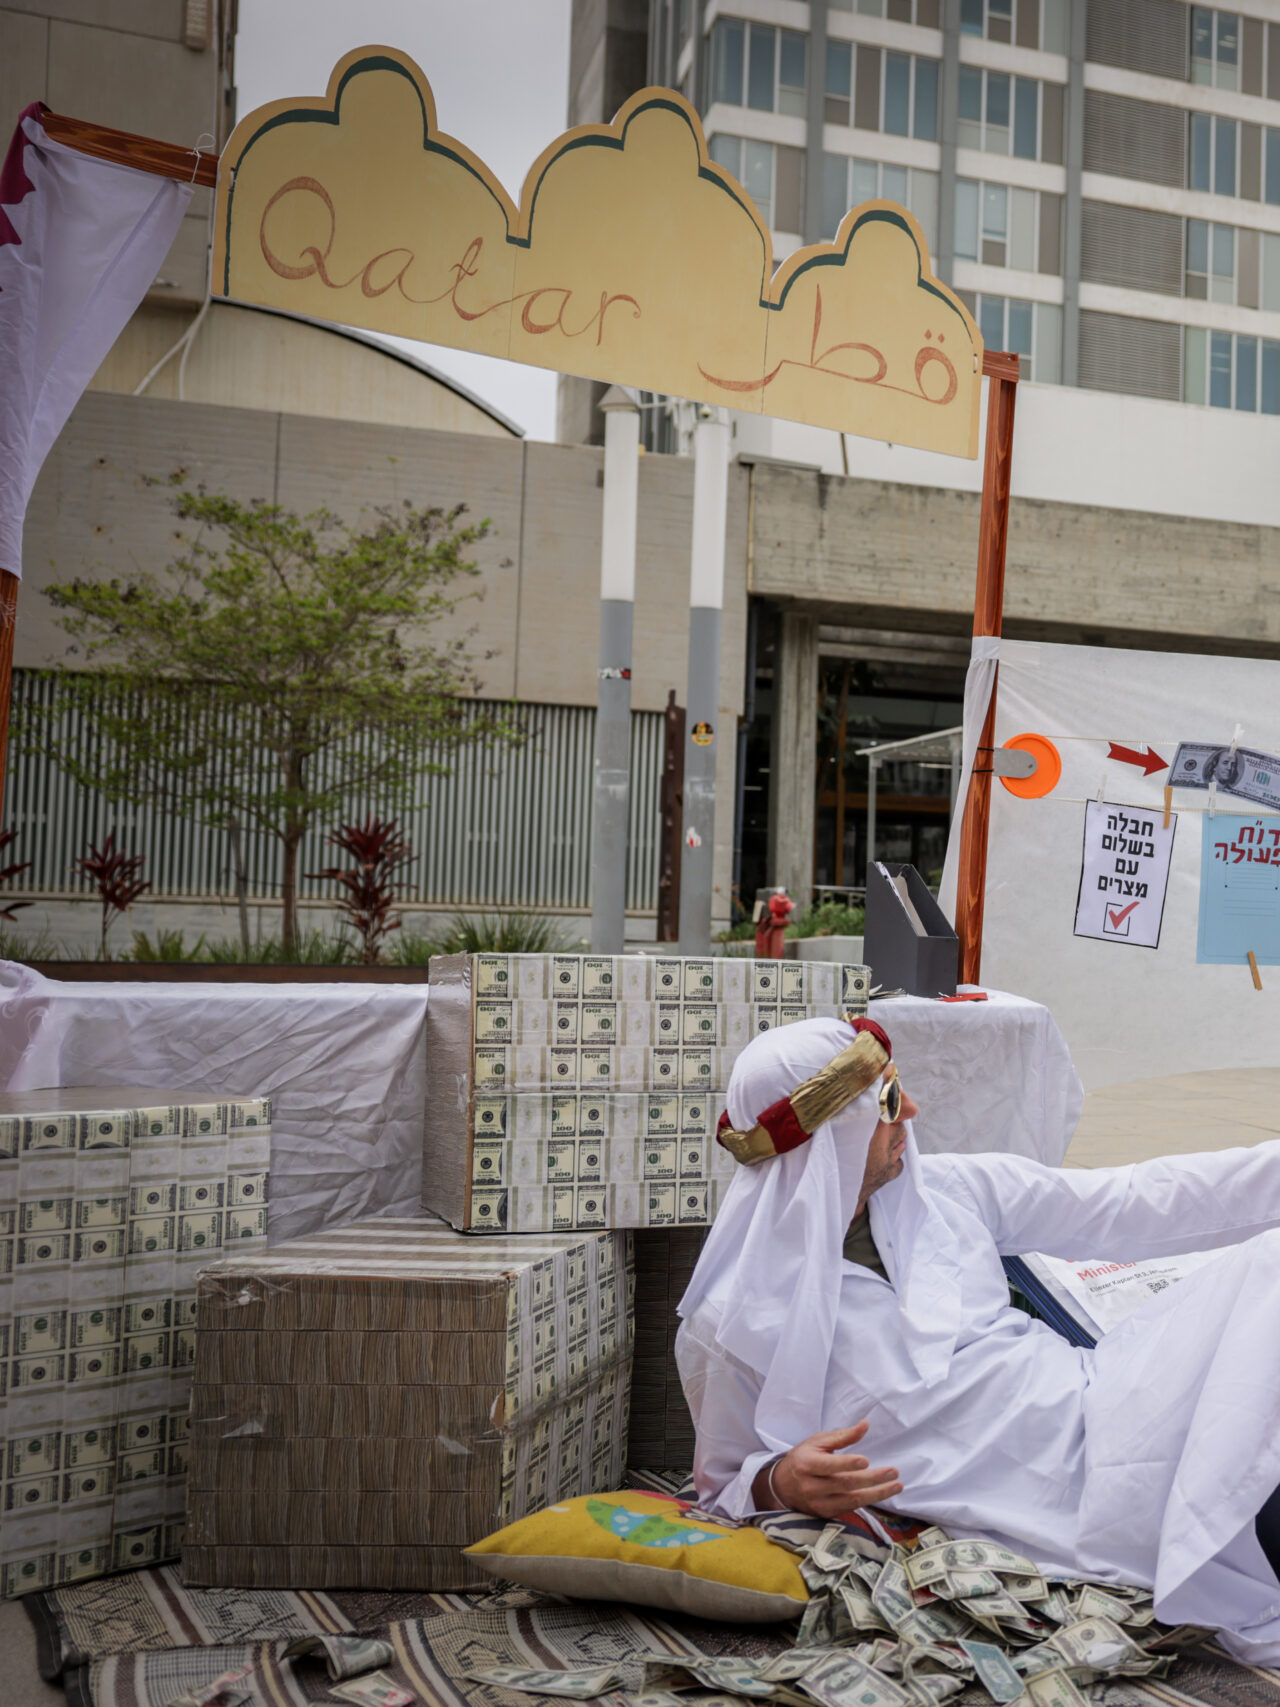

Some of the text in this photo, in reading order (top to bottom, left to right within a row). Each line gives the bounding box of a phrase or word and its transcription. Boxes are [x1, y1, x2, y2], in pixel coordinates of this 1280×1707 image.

[259, 175, 641, 345] Qatar
[697, 284, 958, 405] قطر
[1107, 813, 1153, 837] חבלה
[1102, 834, 1155, 858] בשלום
[1115, 858, 1139, 876] עם
[1098, 875, 1149, 898] מצרים
